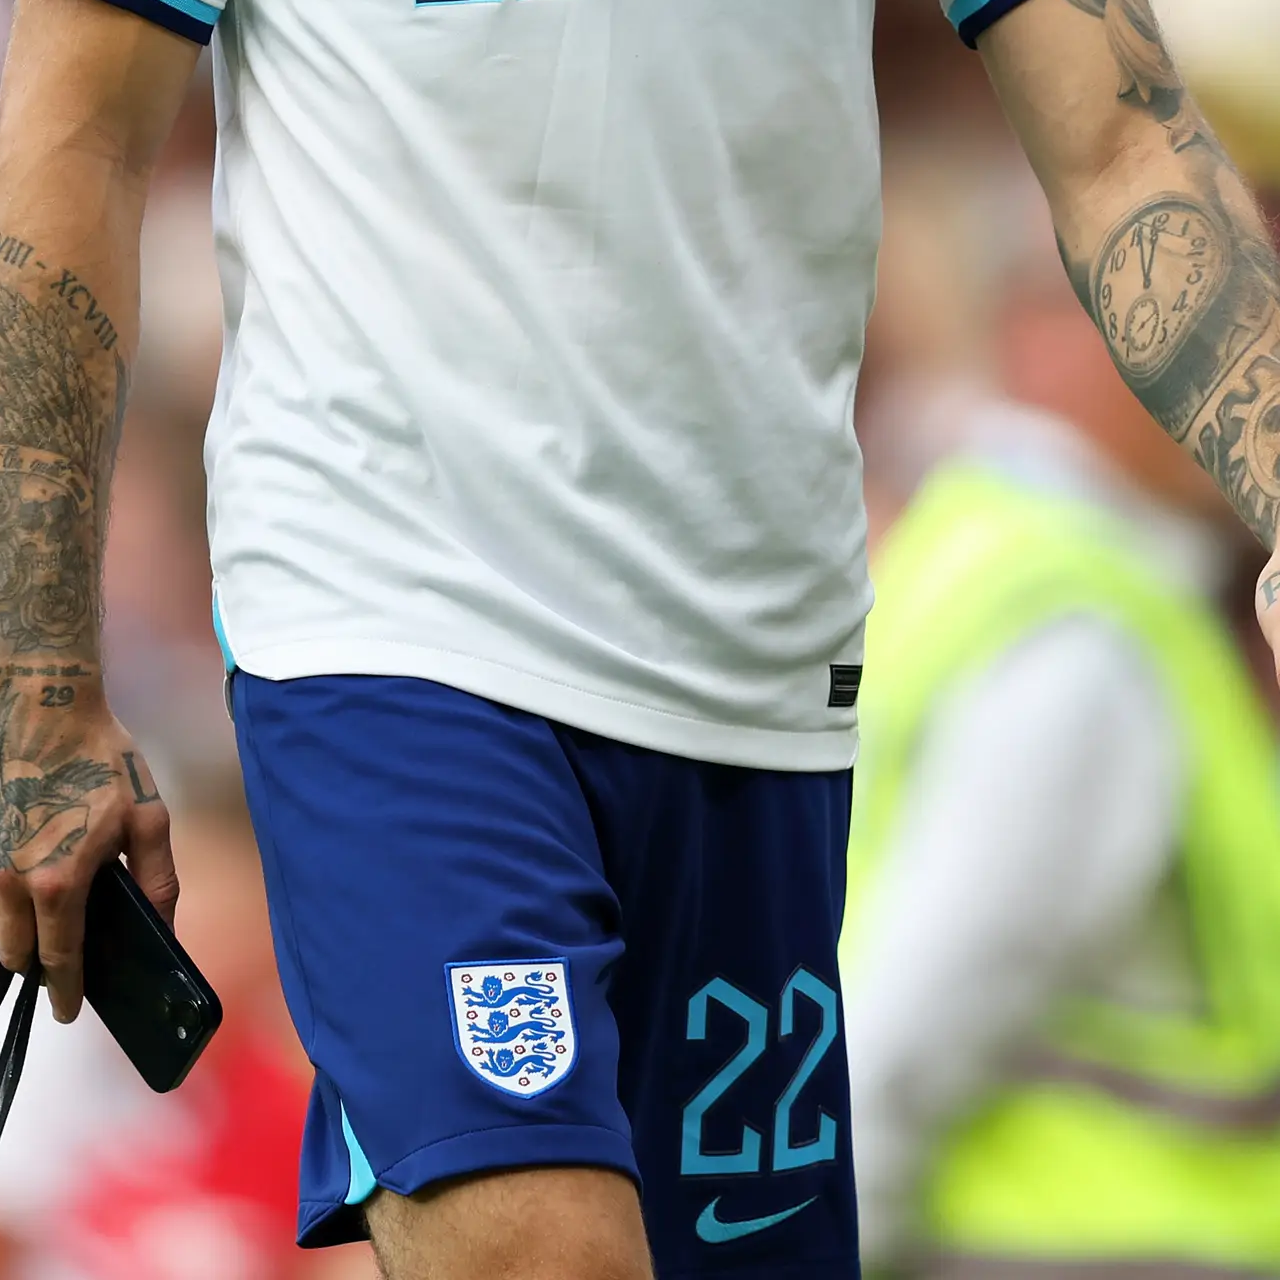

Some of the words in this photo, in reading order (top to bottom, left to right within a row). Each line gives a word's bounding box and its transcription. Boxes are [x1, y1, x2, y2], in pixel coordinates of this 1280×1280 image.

[40, 685, 74, 707] 29
[122, 750, 162, 804] L
[680, 966, 838, 1176] 22
